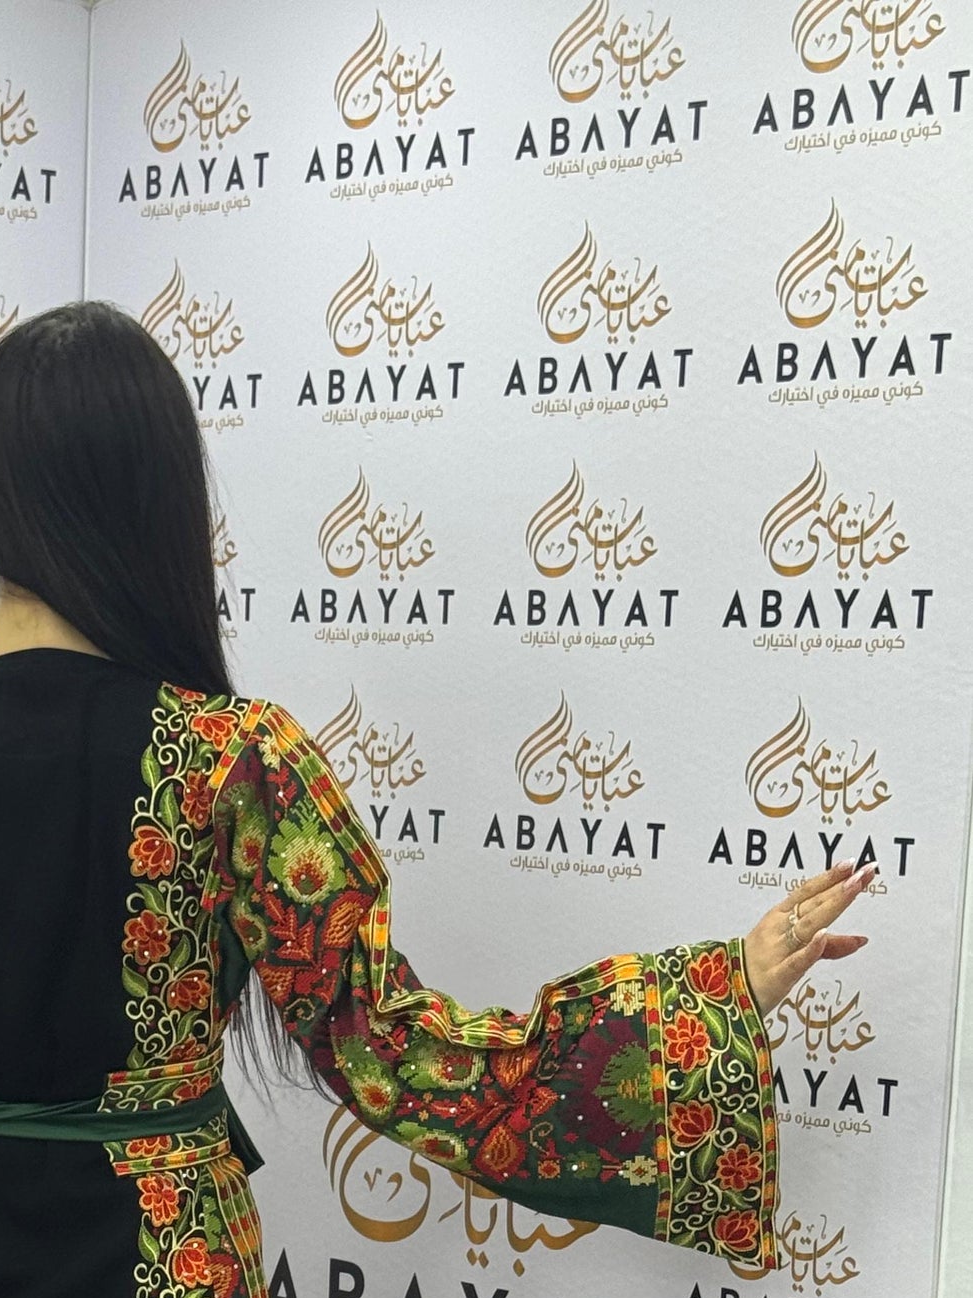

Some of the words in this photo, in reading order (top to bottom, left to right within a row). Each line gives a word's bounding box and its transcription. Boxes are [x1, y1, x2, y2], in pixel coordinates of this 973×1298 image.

[752, 69, 971, 134] ABAYAT
[515, 100, 708, 161] ABAYAT
[833, 129, 857, 155] في
[900, 120, 943, 148] كوني
[305, 127, 475, 183] ABAYAT
[119, 151, 270, 203] ABAYAT
[504, 348, 694, 397] ABAYAT
[737, 332, 952, 385] ABAYAT
[297, 362, 465, 406] ABAYAT
[816, 385, 840, 409] في
[882, 380, 924, 407] كوني
[574, 397, 595, 420] في
[632, 393, 669, 418] كوني
[290, 588, 455, 625] ABAYAT
[493, 588, 679, 627] ABAYAT
[722, 588, 934, 629] ABAYAT
[562, 631, 583, 653] في
[619, 631, 656, 654] كوني
[800, 633, 823, 657] في
[864, 633, 906, 658] كوني
[483, 813, 666, 860] ABAYAT
[551, 858, 571, 879] في
[607, 861, 643, 883] كوني
[772, 1066, 899, 1117] AYAT
